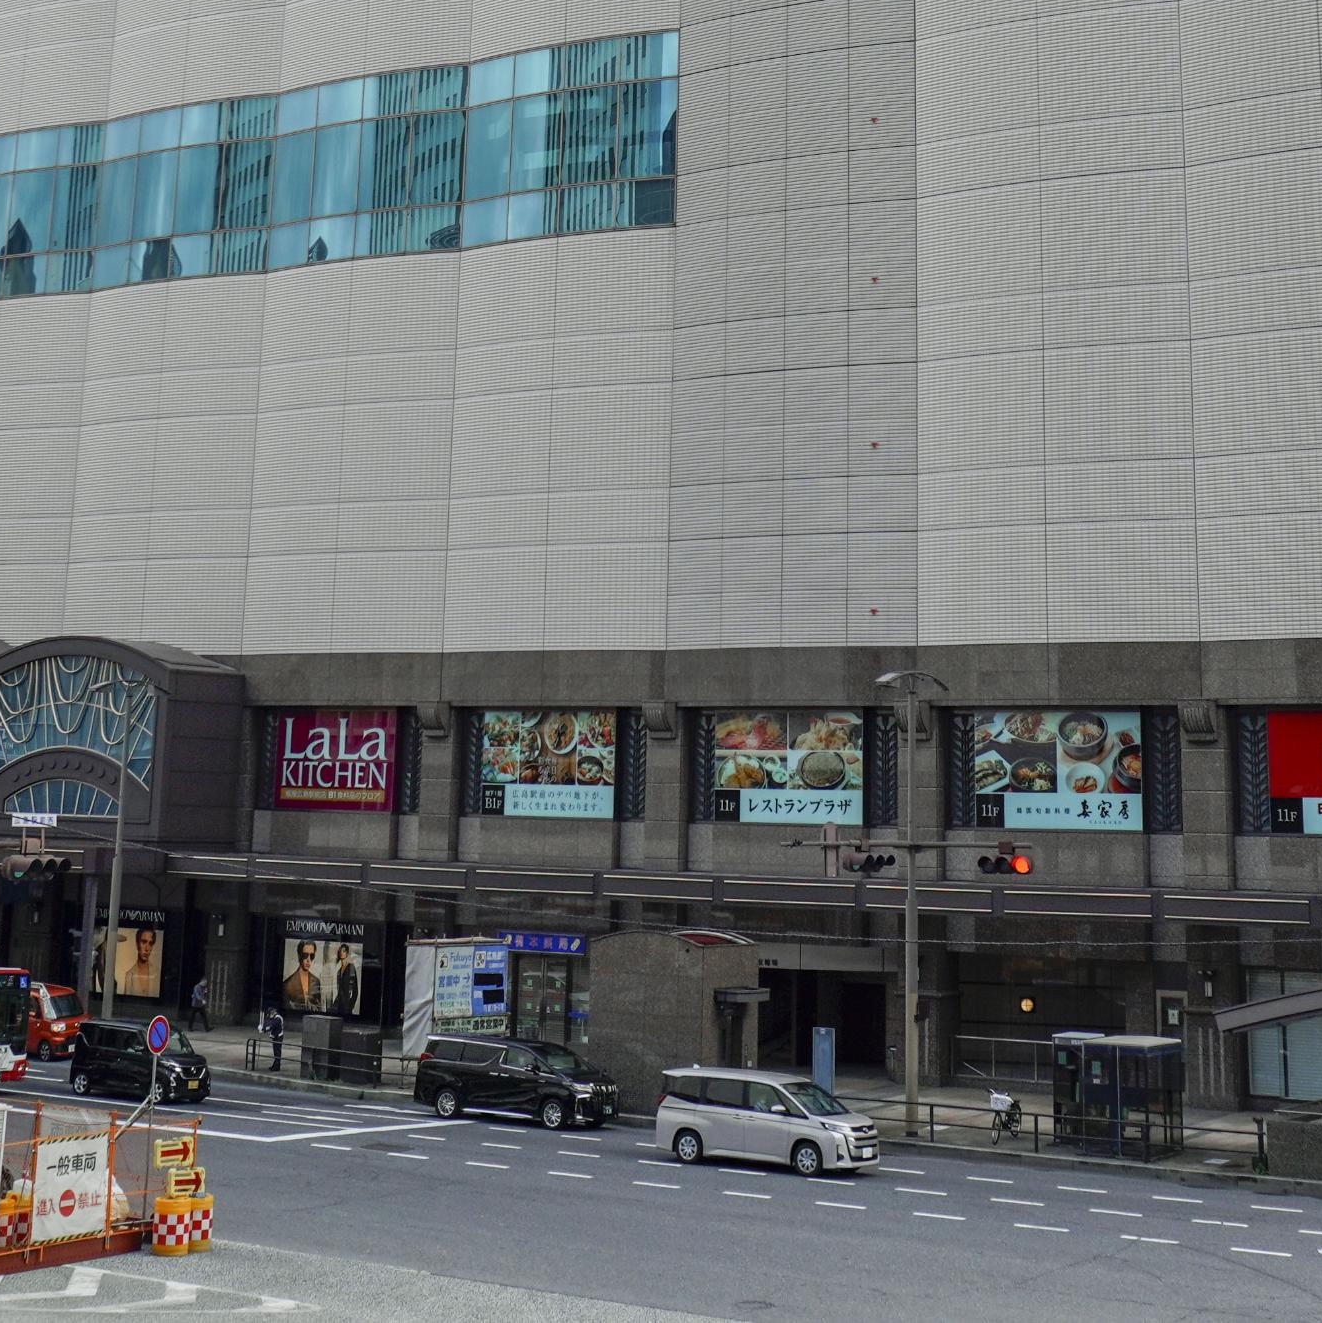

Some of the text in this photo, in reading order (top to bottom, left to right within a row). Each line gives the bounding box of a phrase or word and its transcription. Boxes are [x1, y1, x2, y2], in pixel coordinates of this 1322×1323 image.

[281, 760, 387, 790] KITCHEN
[485, 797, 503, 809] B1F
[720, 799, 736, 812] 11F
[748, 798, 852, 815] レストランプラザ
[981, 804, 1000, 817] 11F
[1277, 809, 1298, 822] 11F
[136, 910, 166, 923] ARMANI
[286, 920, 365, 935] EMPORIO ARMANI
[46, 1151, 97, 1177] 一般車両
[37, 1189, 103, 1216] 進入 禁止
